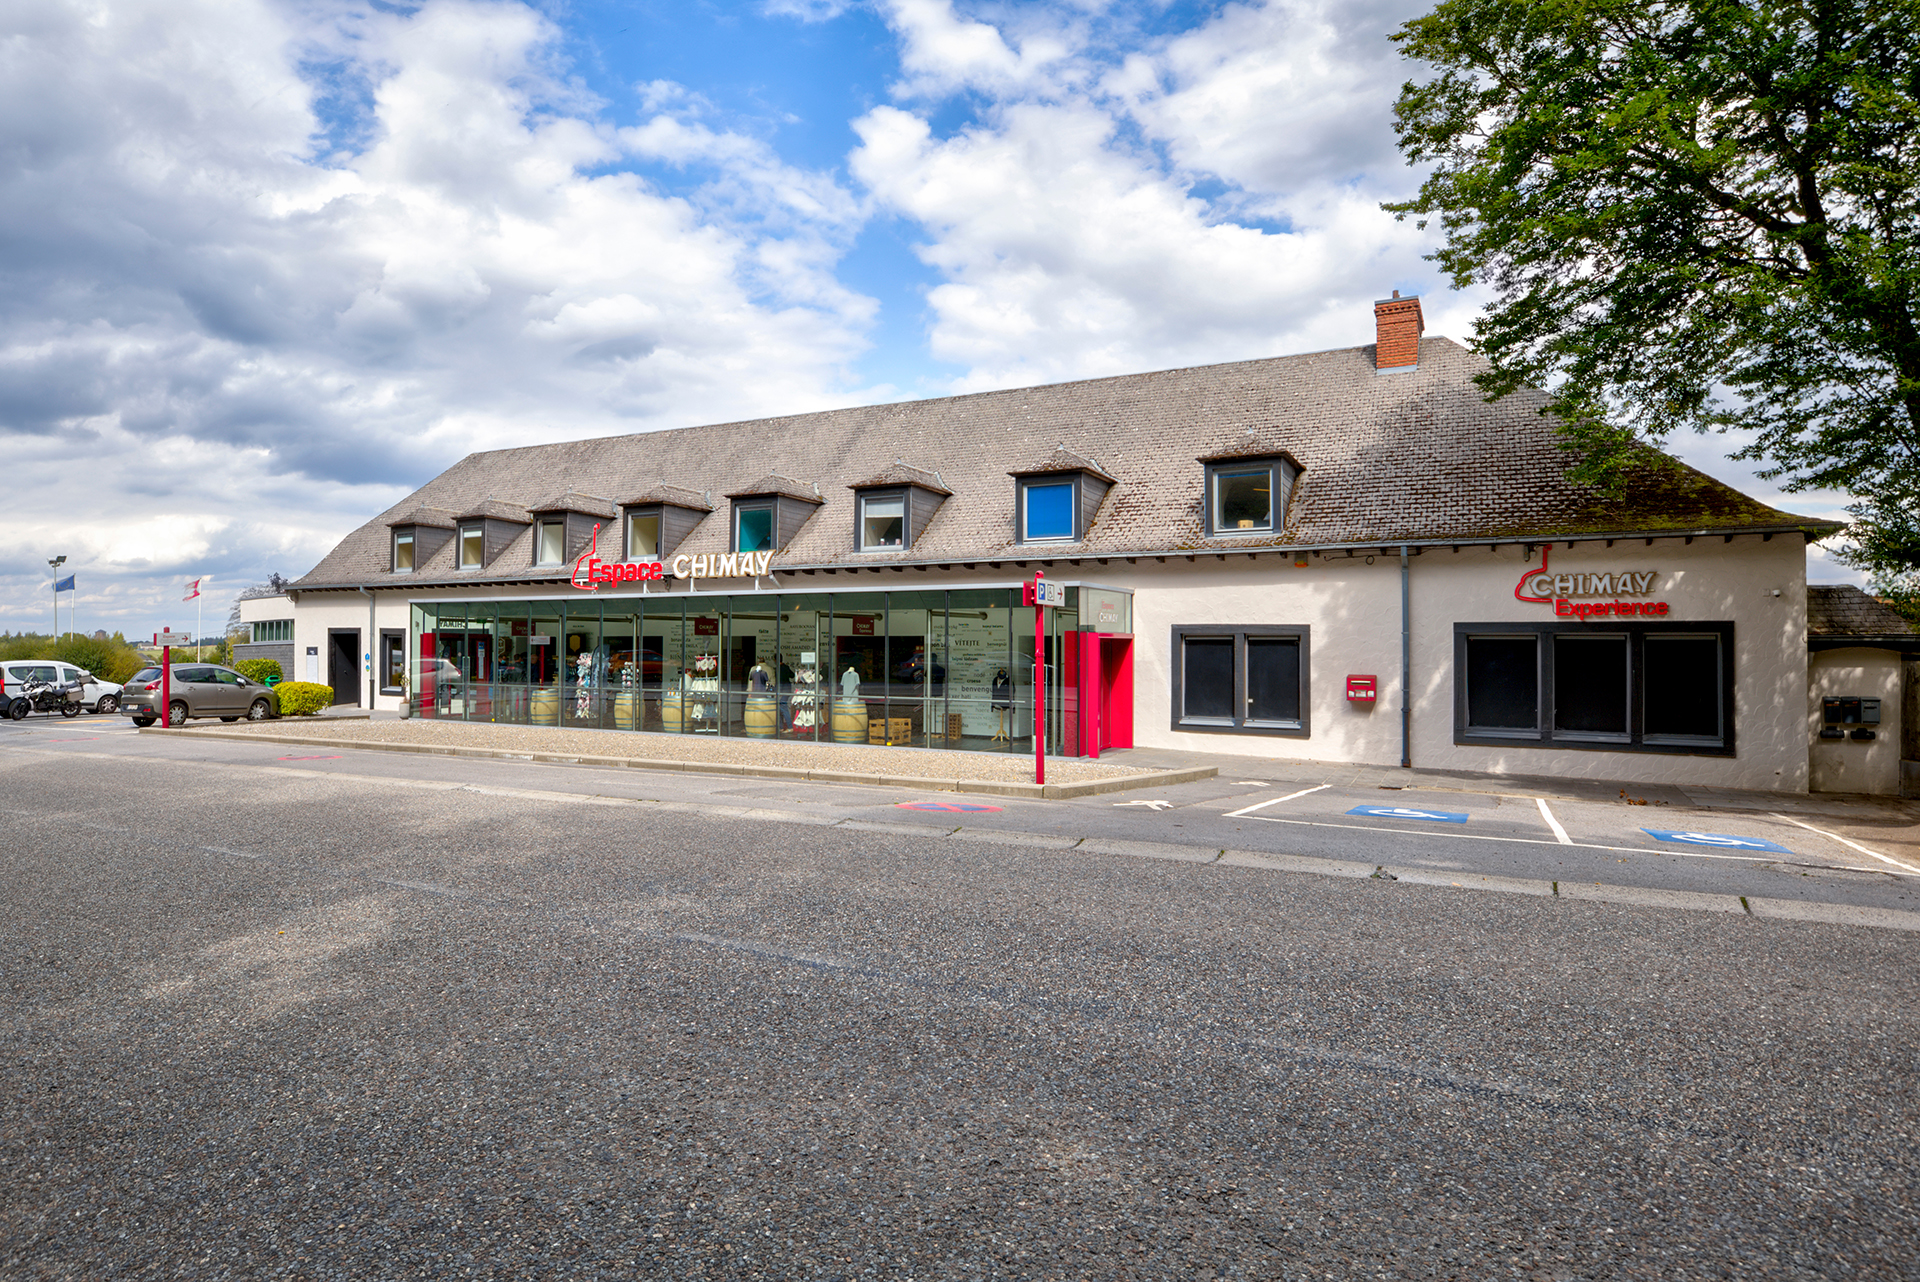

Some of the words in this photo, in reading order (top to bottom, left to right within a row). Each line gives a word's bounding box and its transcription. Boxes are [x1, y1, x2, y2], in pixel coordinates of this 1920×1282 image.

[588, 558, 663, 588] Espace
[672, 549, 776, 579] CHIMAY
[1039, 584, 1045, 598] P
[1529, 572, 1657, 596] CHIMAY
[1098, 612, 1119, 623] CHIMAY
[1555, 599, 1669, 621] Experience
